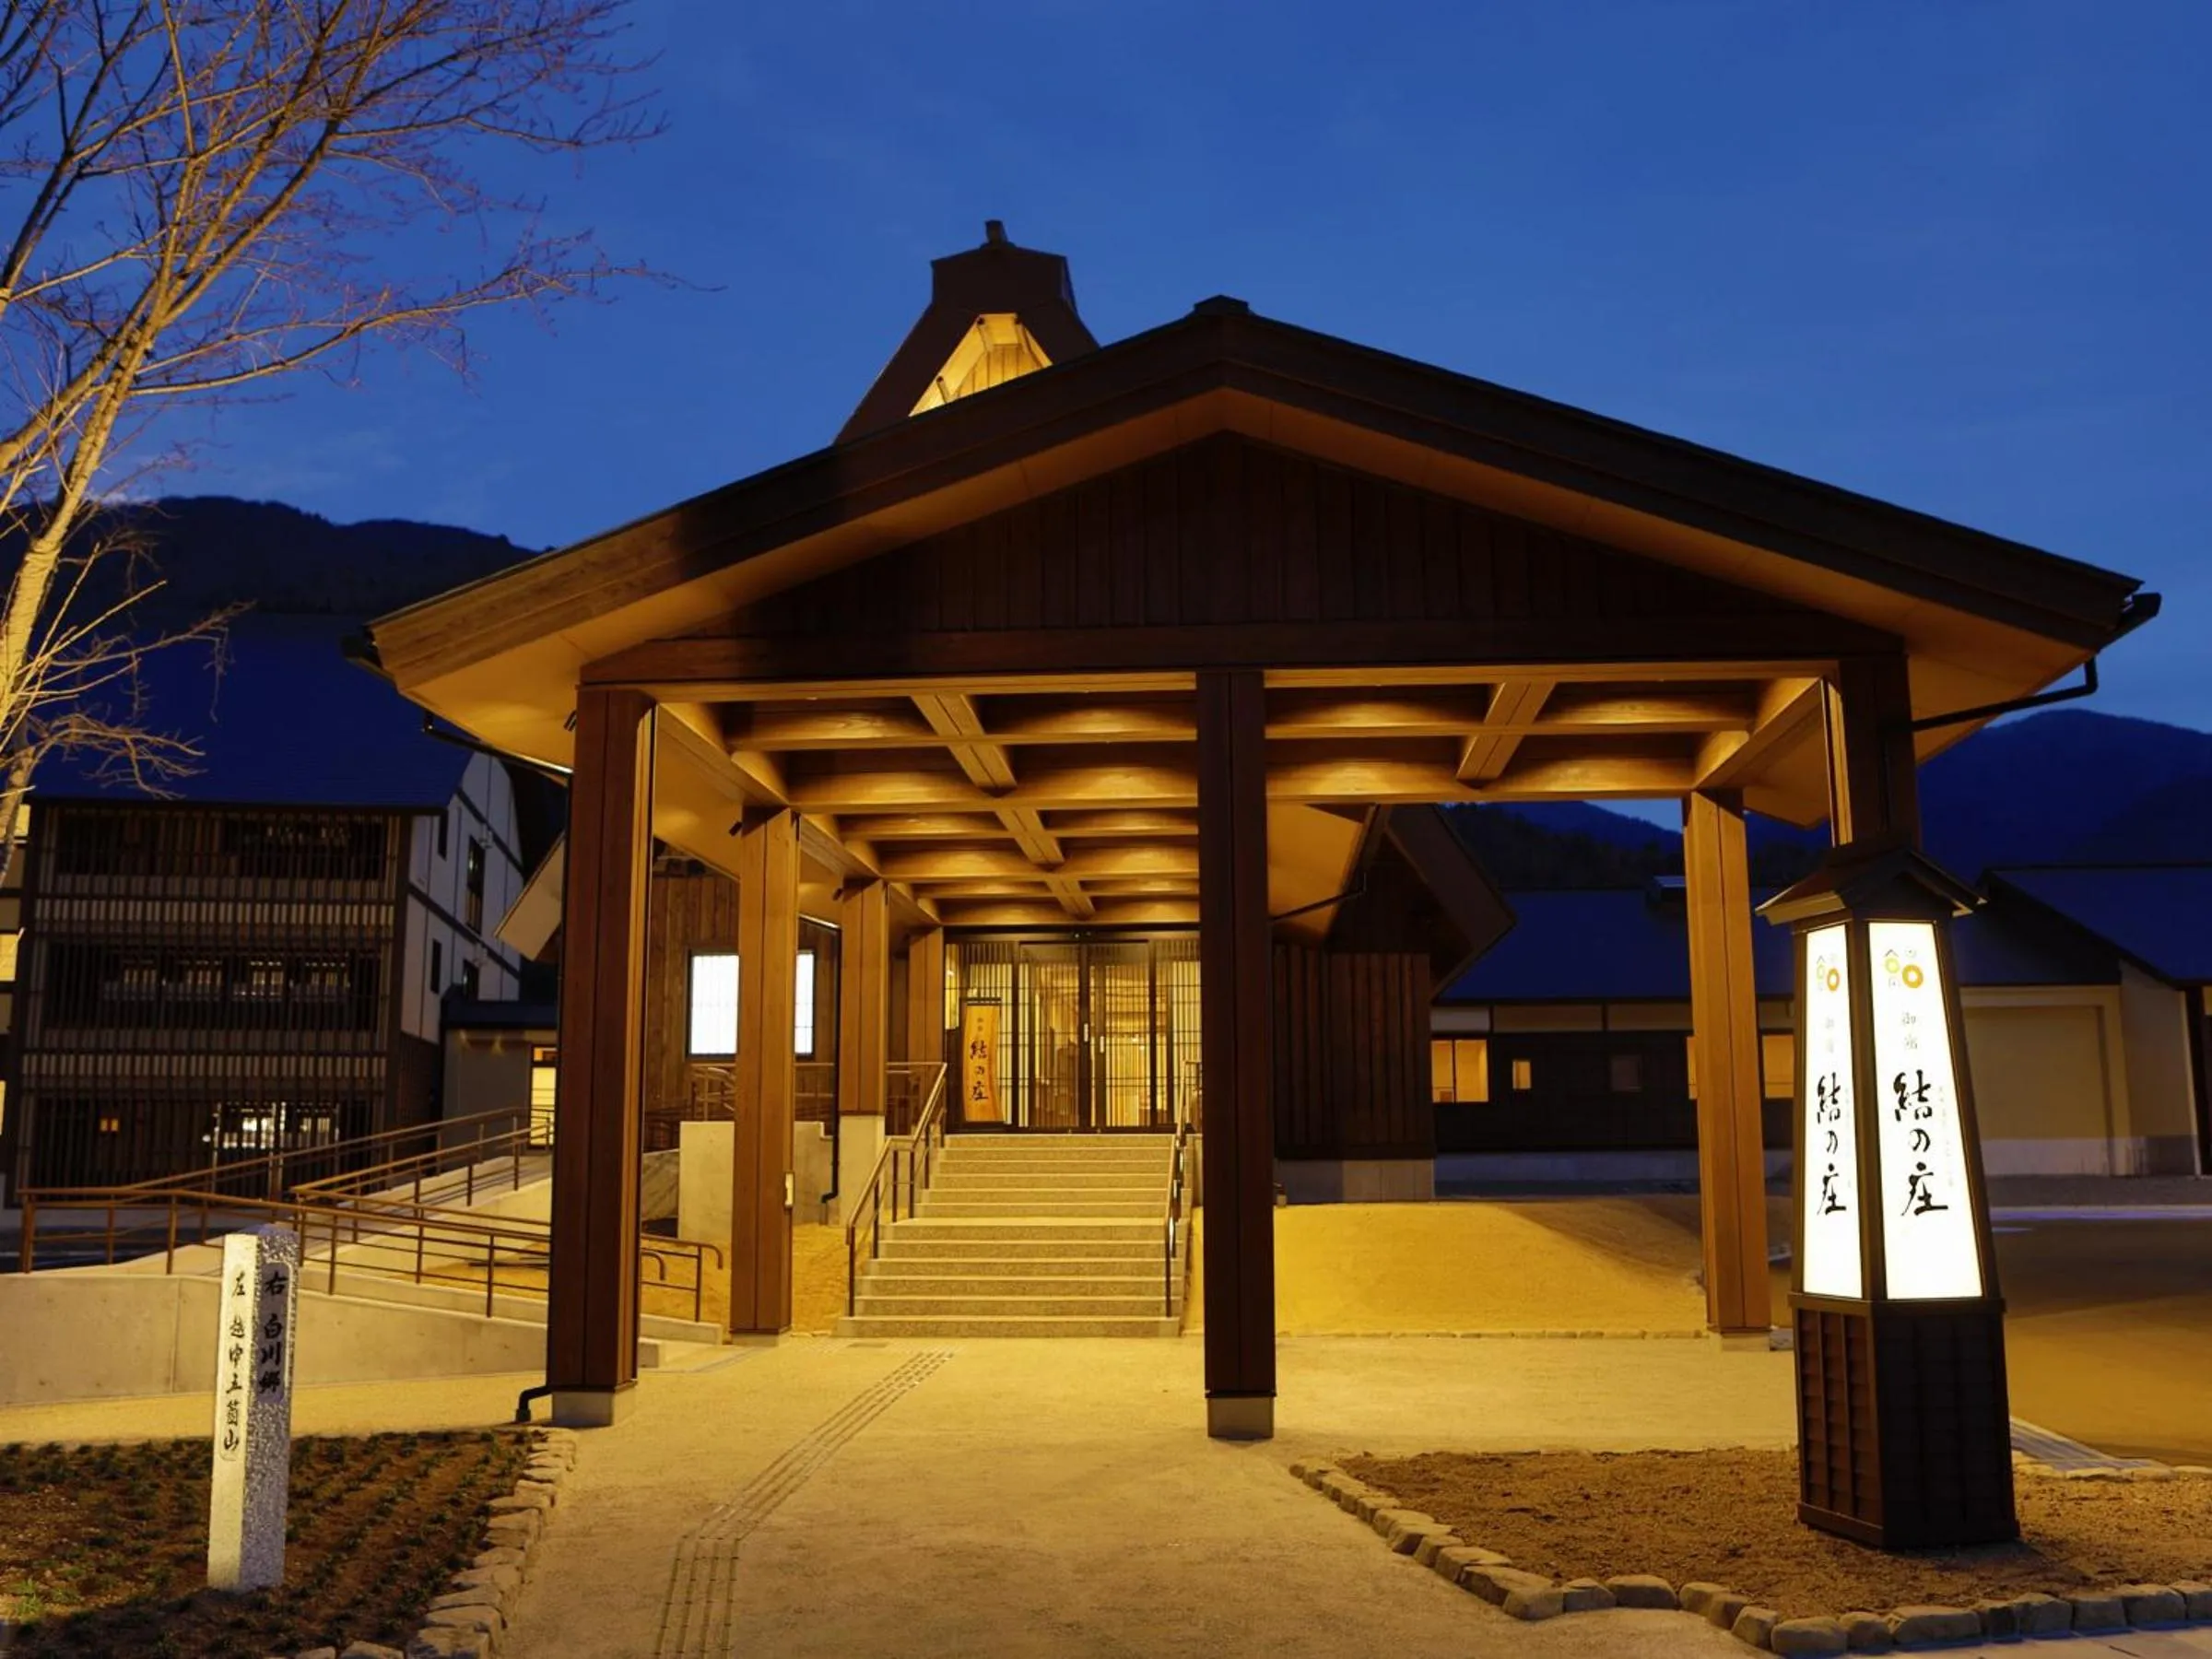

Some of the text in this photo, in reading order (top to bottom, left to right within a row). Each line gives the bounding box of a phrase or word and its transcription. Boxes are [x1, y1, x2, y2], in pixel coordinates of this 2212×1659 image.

[970, 1040, 989, 1101] 結の庄
[1817, 1071, 1847, 1216] 結の庄
[1892, 1068, 1949, 1217] 結の庄
[265, 1270, 289, 1297] 右
